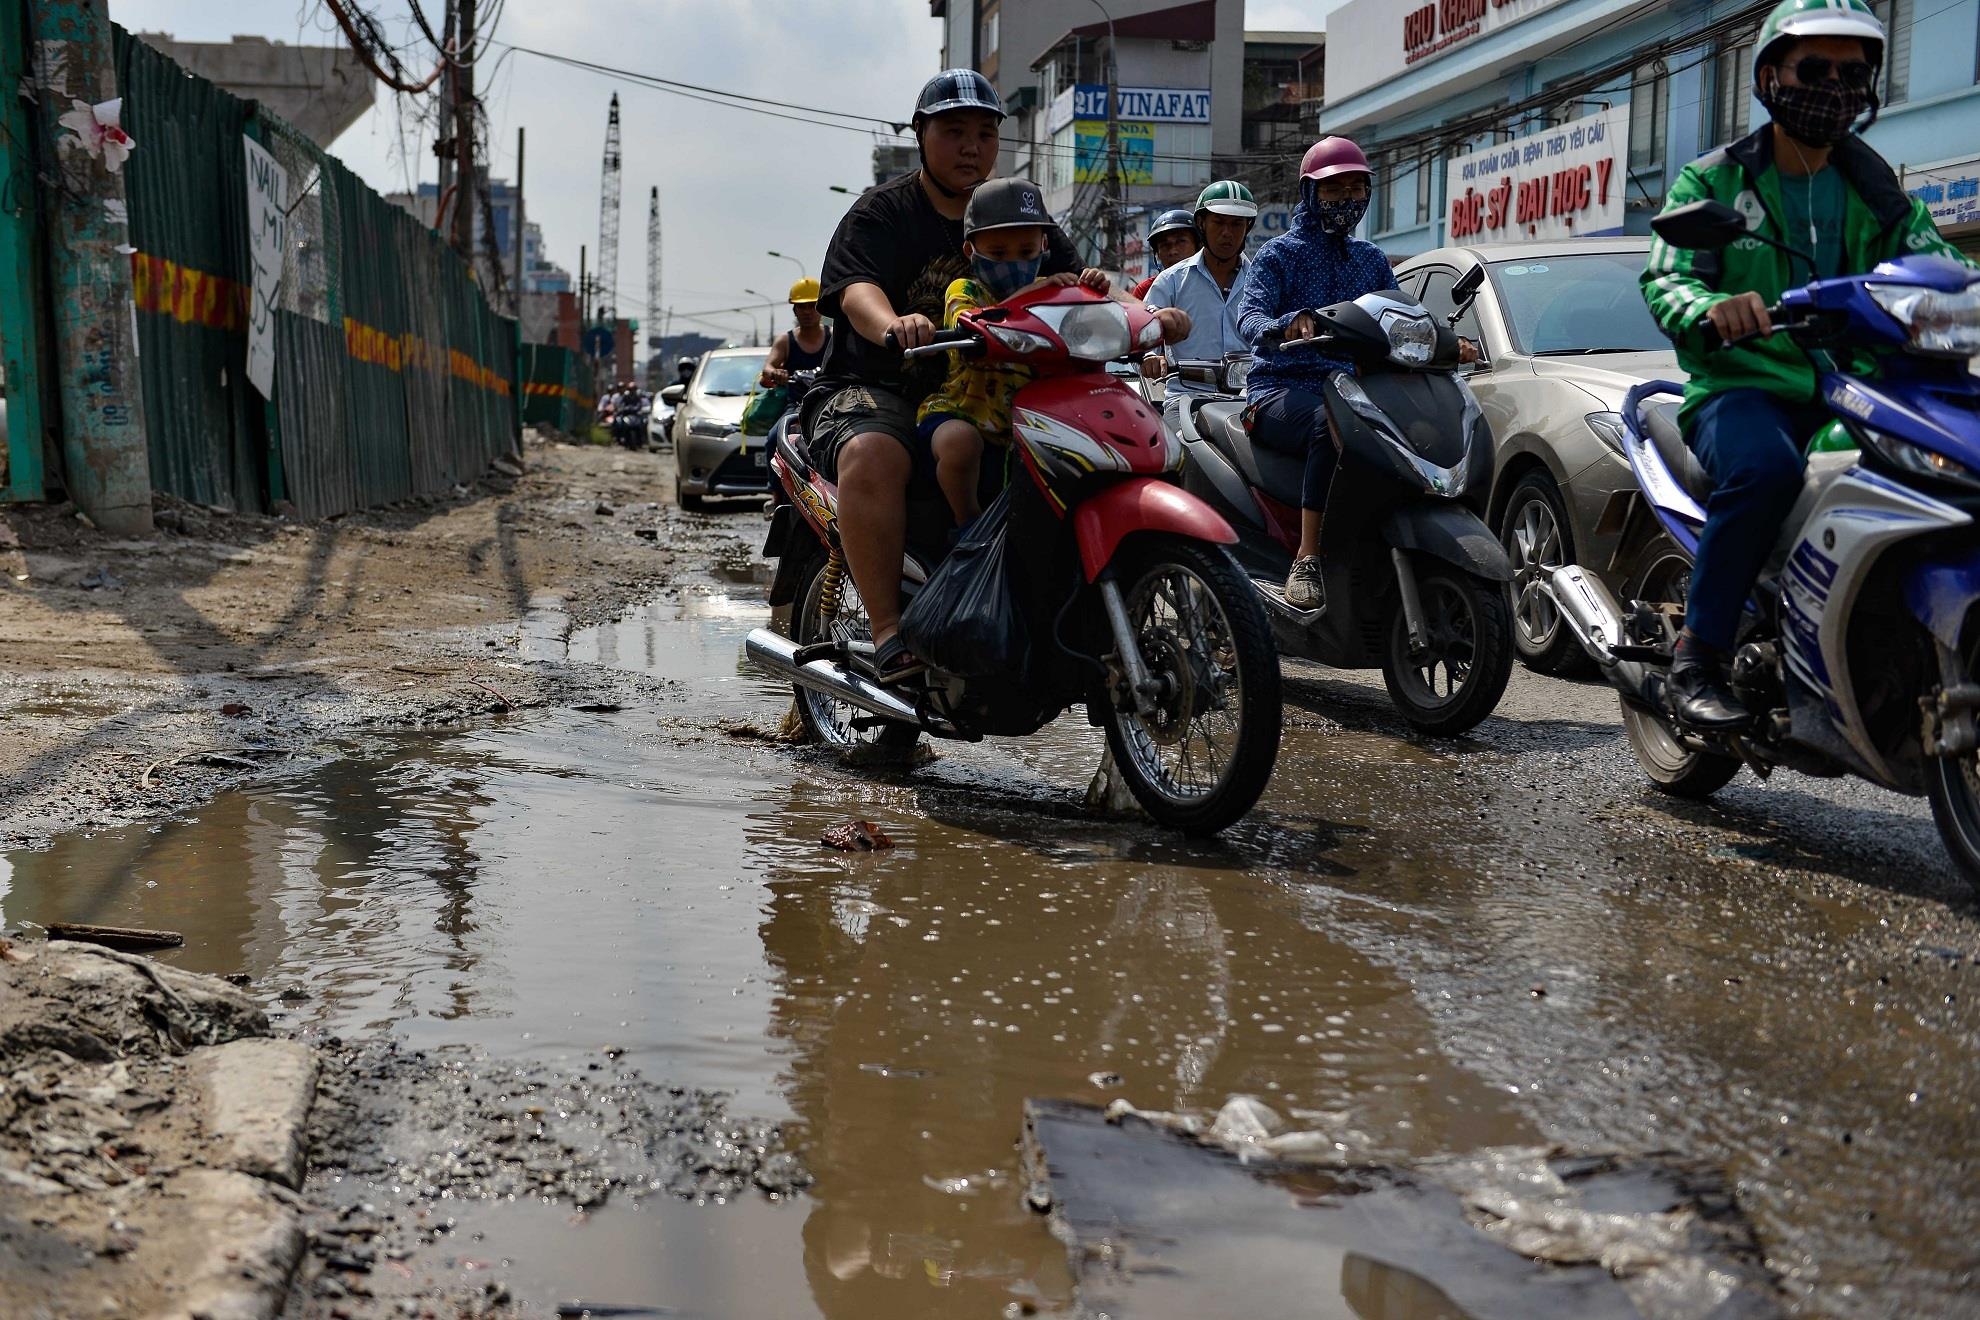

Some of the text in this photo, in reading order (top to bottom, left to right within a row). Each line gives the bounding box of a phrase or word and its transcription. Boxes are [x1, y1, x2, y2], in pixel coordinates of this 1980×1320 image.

[1403, 3, 1435, 51] KHU
[1074, 91, 1209, 118] 217 VINAFAT
[1451, 187, 1484, 239] BÁC
[1516, 176, 1549, 236] ĐẠI
[1550, 164, 1592, 227] HỌC
[1595, 157, 1613, 206] Y
